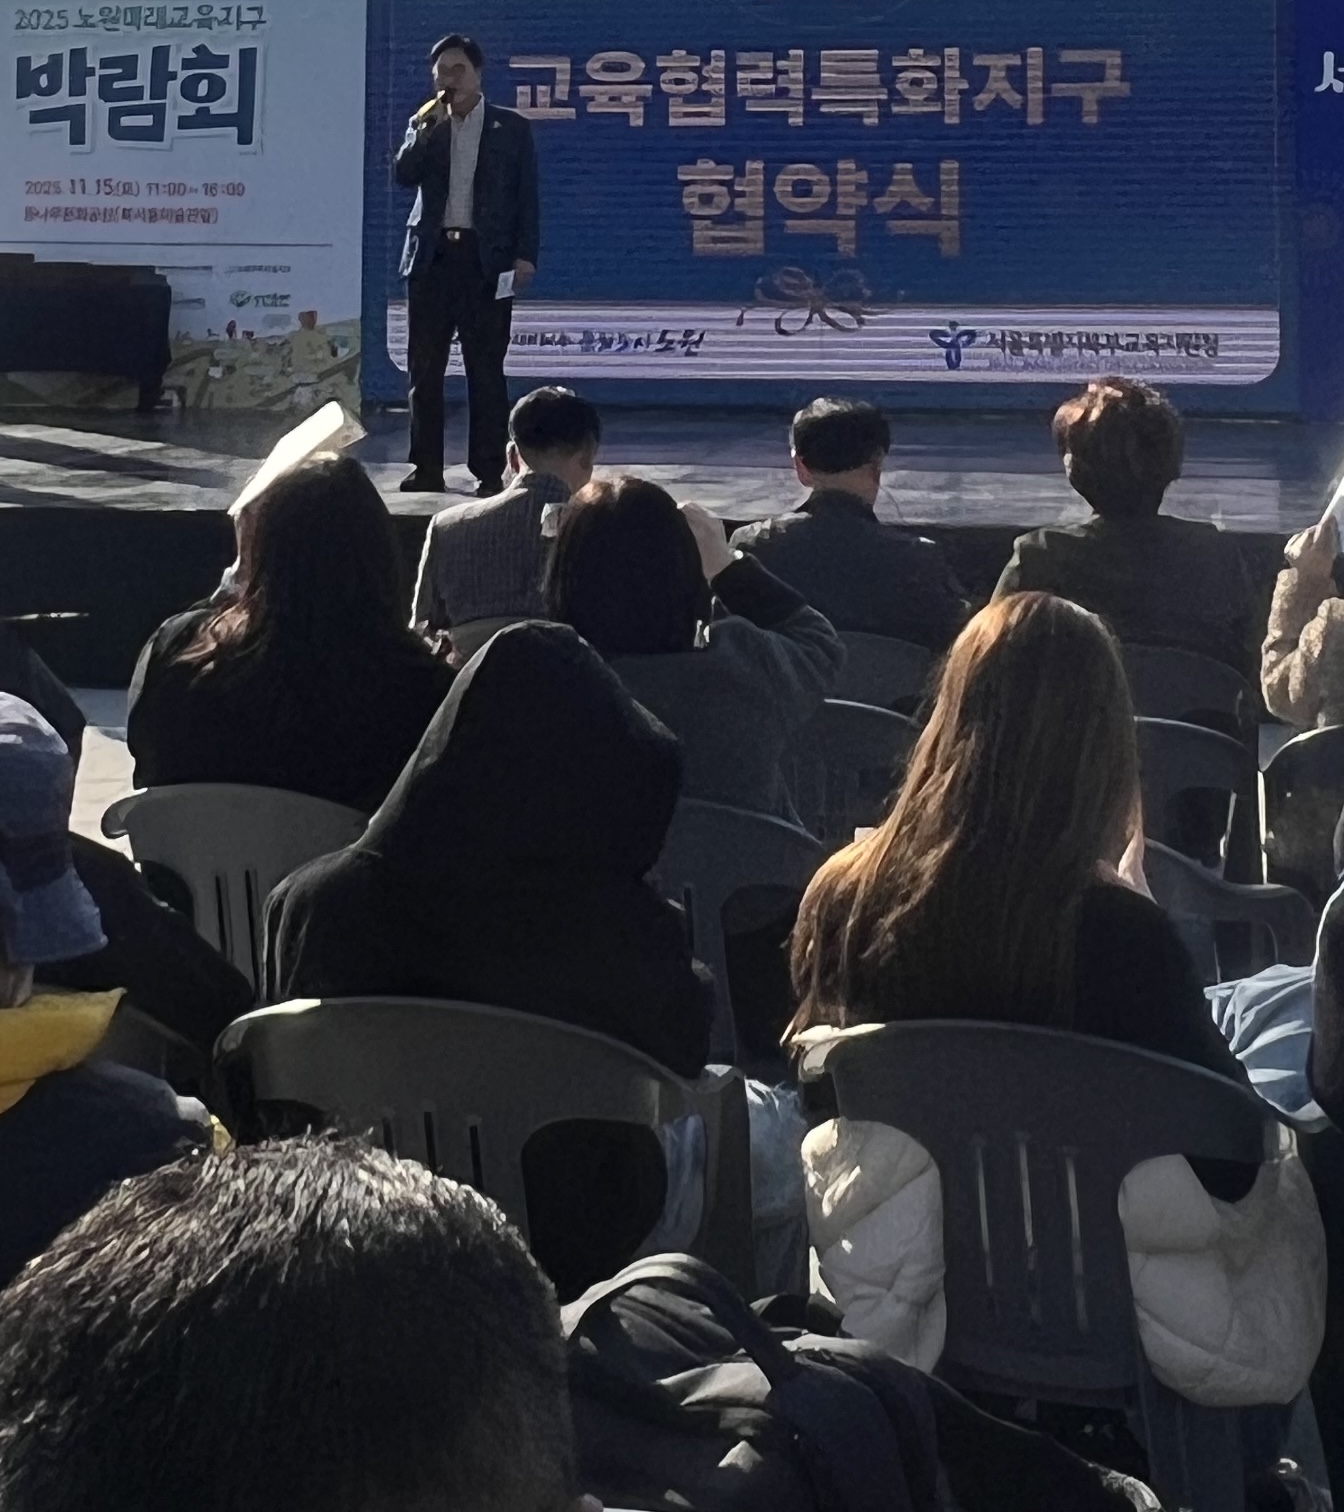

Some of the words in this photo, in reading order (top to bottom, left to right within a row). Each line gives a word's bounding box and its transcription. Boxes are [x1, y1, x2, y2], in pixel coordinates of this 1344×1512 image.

[15, 8, 68, 30] 2025
[73, 4, 268, 31] 노원미래교육지구
[15, 44, 259, 146] 박람회
[508, 46, 1131, 127] 교육협력특화지구
[676, 159, 962, 257] 협약식
